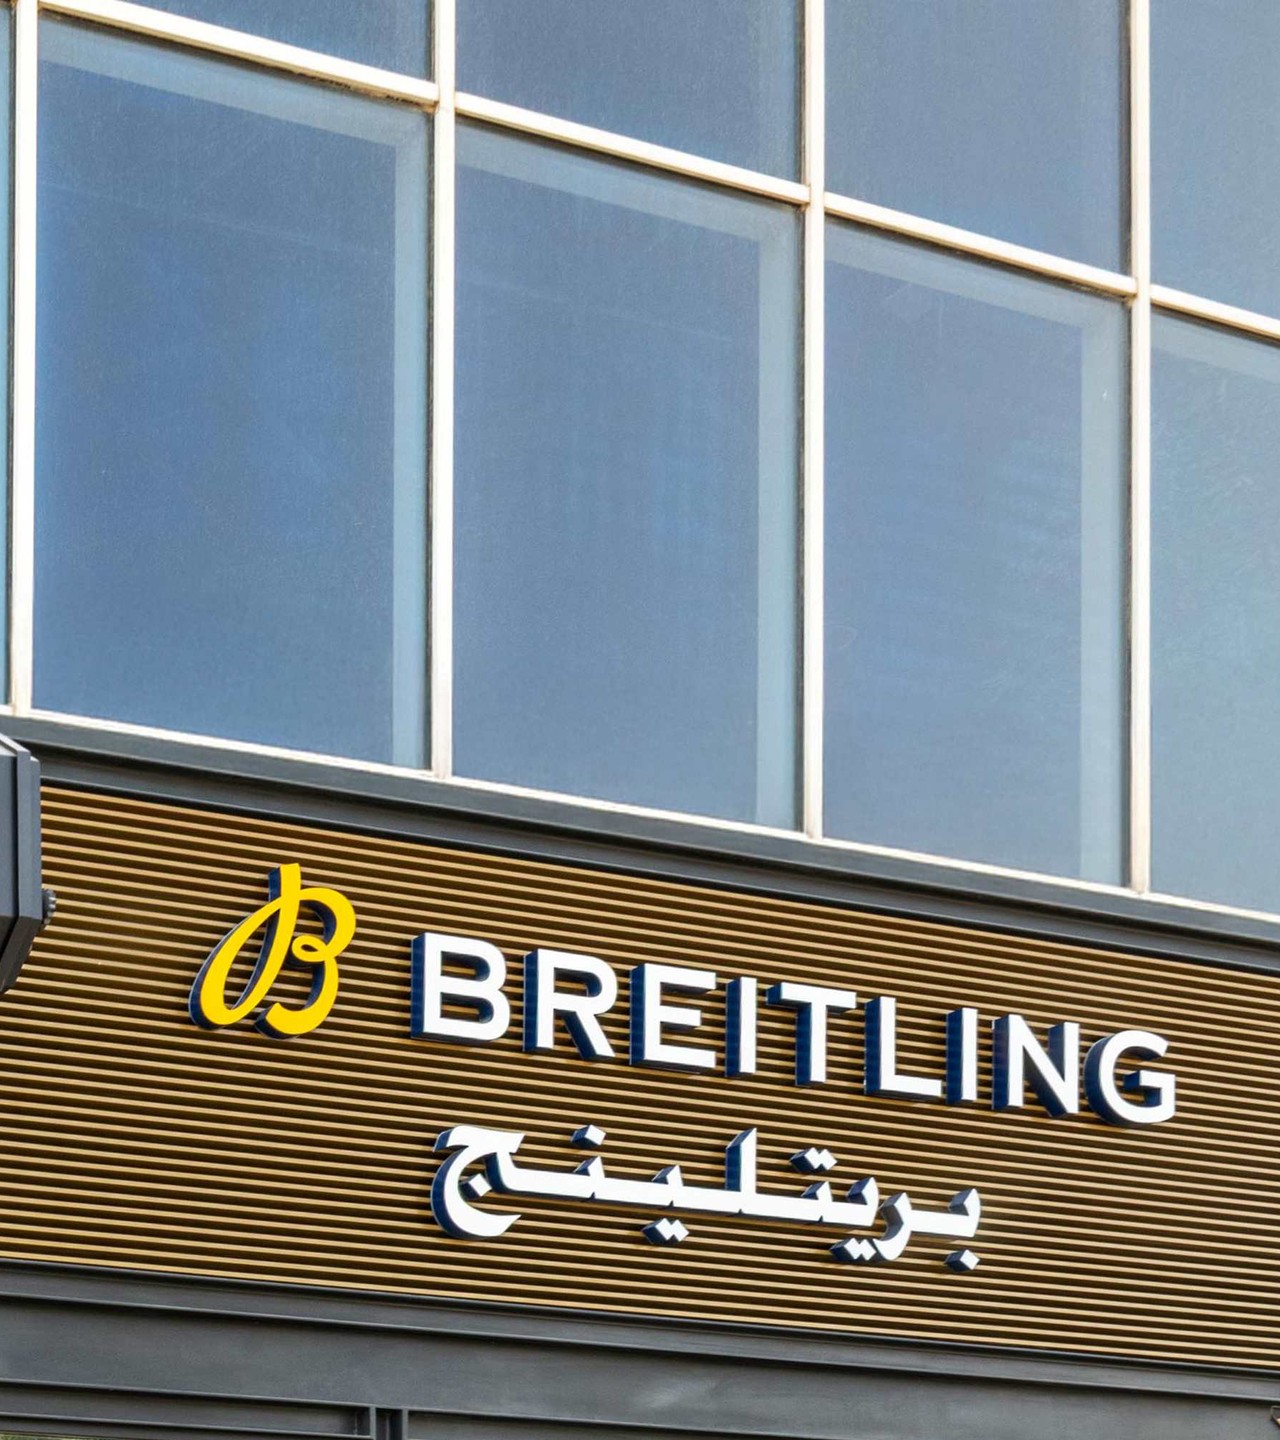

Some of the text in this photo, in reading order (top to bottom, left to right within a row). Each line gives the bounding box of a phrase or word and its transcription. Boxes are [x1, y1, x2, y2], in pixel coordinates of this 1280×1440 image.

[196, 863, 1177, 1125] B BREITLING
[435, 1124, 981, 1270] بريتلينج
